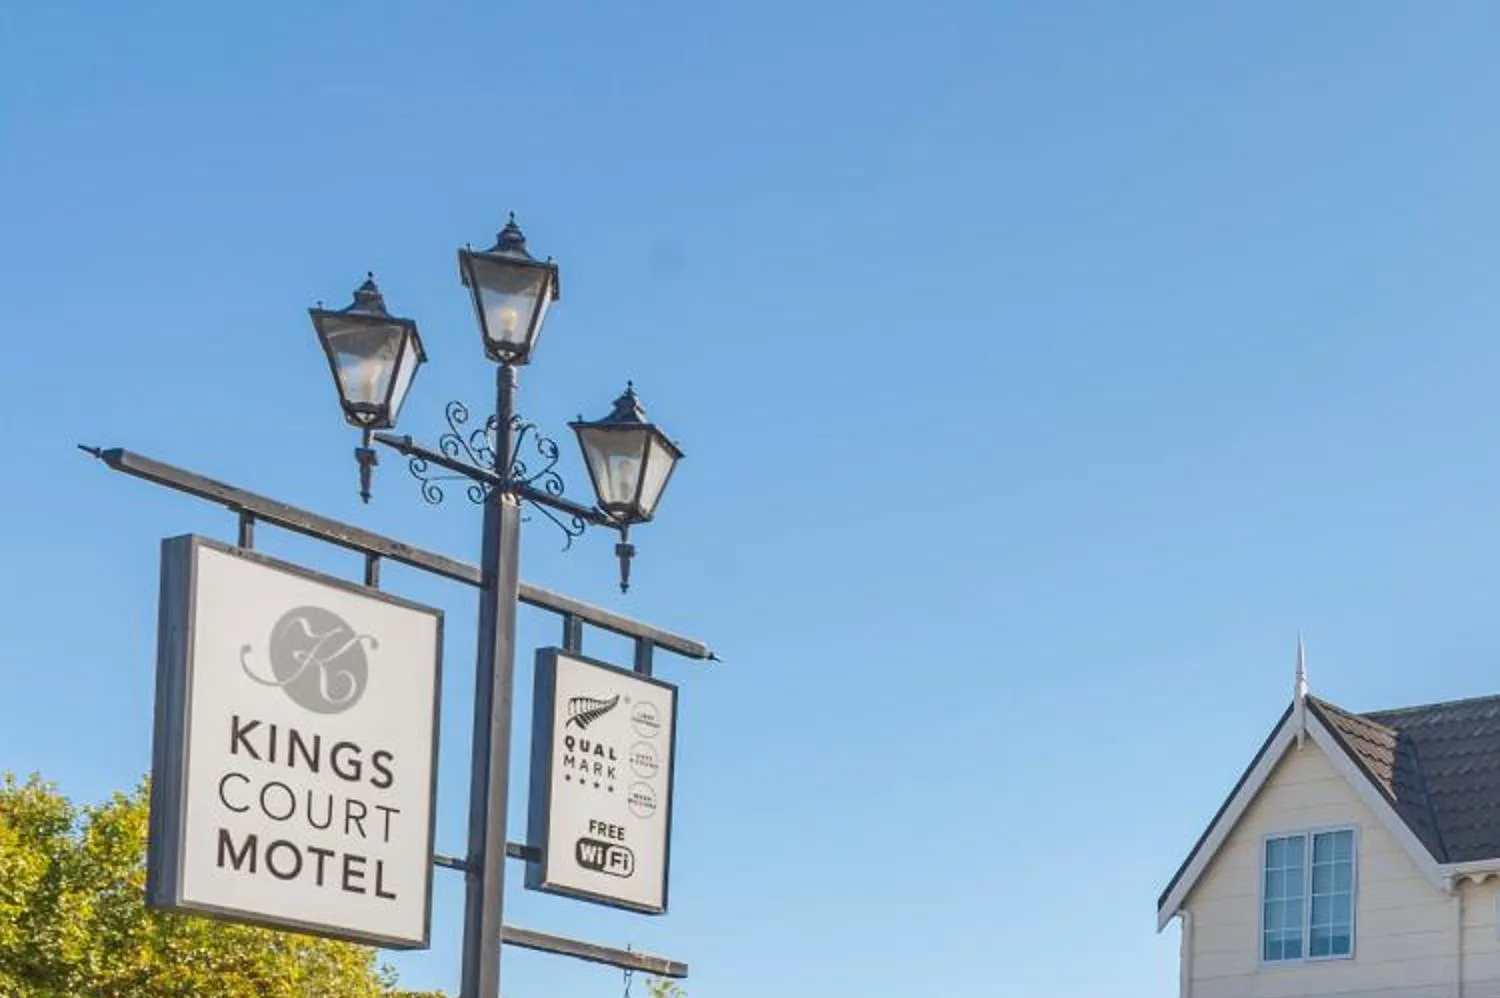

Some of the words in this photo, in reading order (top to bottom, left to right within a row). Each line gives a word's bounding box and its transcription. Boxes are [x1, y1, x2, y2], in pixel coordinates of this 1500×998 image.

[231, 715, 395, 789] KINGS
[563, 754, 616, 780] MARK
[564, 735, 617, 761] QUAL
[218, 772, 401, 842] COURT
[589, 819, 625, 841] FREE
[216, 828, 397, 900] MOTEL
